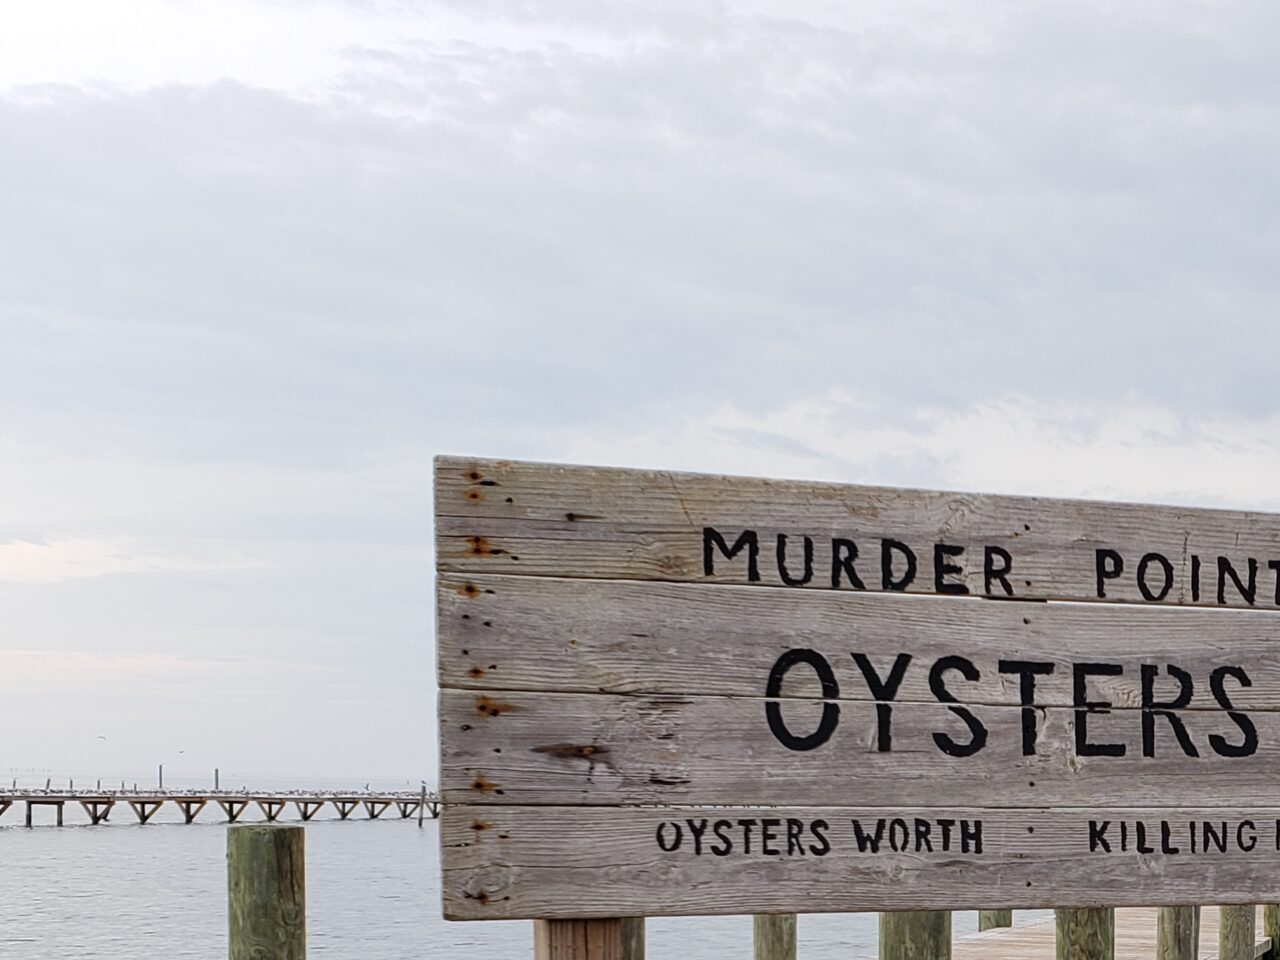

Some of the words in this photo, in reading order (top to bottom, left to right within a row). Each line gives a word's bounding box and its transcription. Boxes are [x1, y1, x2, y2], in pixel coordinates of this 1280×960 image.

[701, 526, 1014, 596] MURDER
[764, 647, 1260, 758] OYSTERS
[655, 817, 831, 857] OYSTERS
[852, 817, 983, 855] WORTH
[1088, 818, 1258, 854] KILLING
